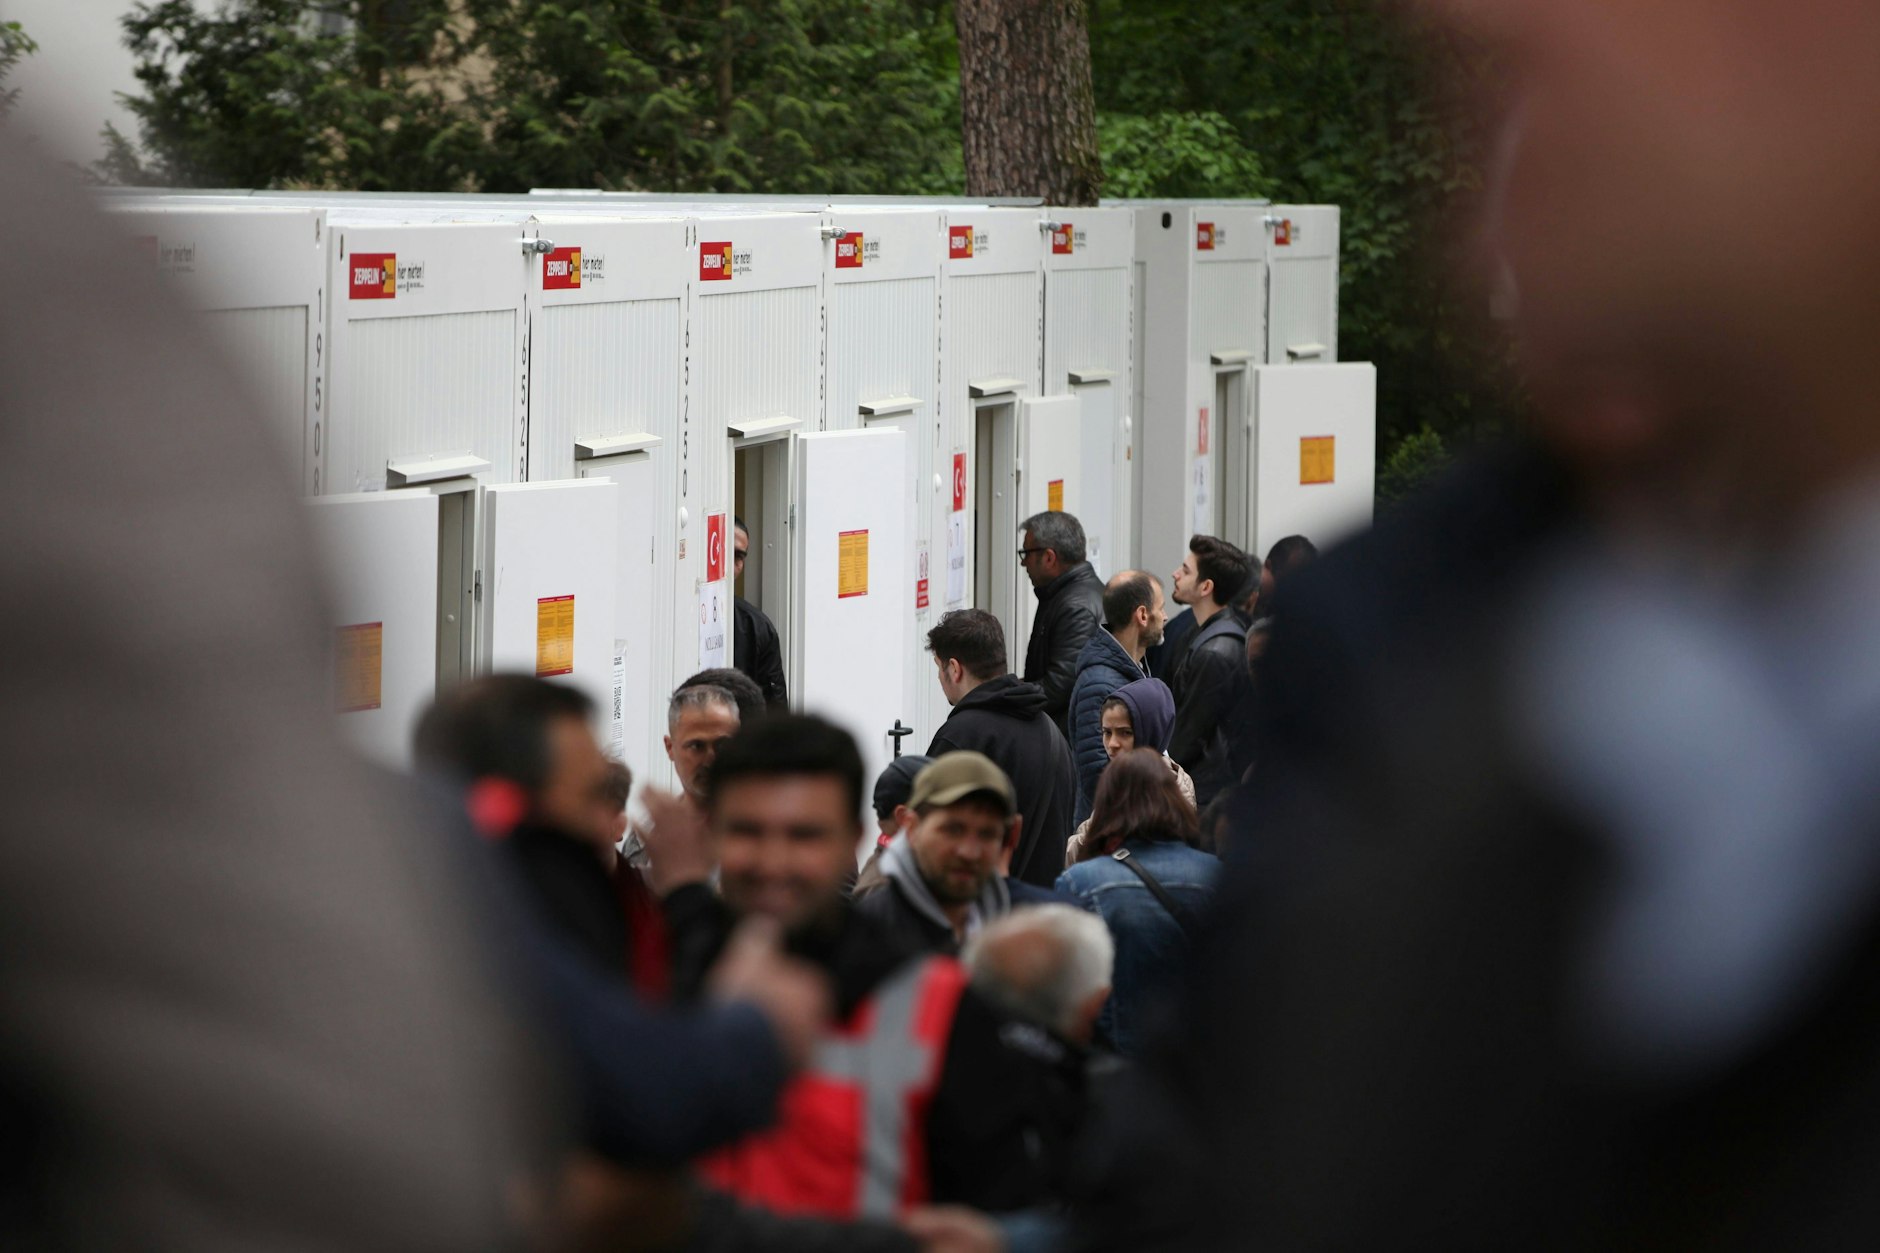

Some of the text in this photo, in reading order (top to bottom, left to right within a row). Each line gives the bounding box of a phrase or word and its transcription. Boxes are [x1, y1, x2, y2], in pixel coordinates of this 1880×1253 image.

[354, 267, 380, 286] ZEPPELIN
[546, 260, 568, 277] ZEPPELIN
[712, 595, 718, 623] 8
